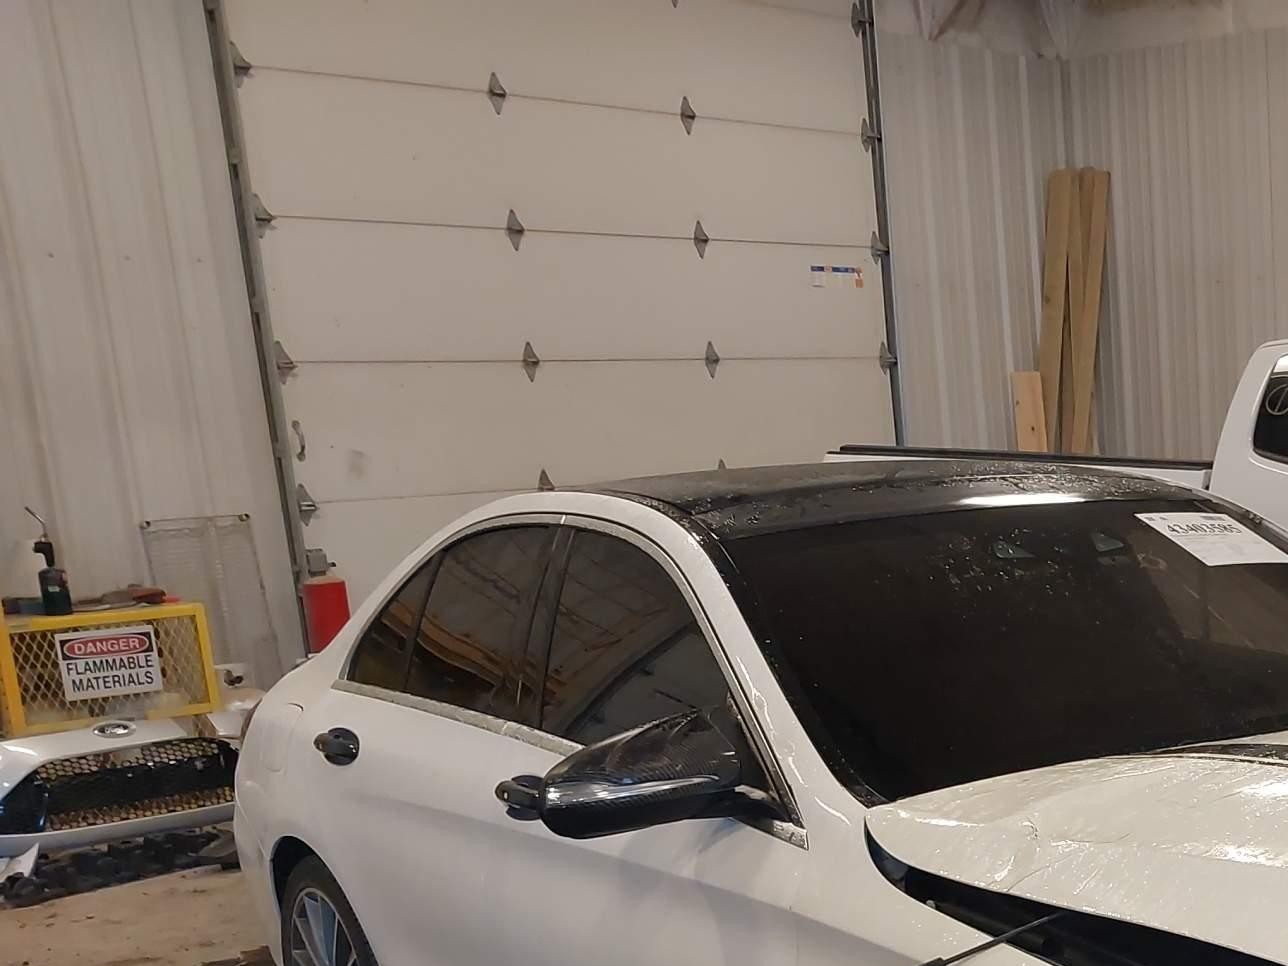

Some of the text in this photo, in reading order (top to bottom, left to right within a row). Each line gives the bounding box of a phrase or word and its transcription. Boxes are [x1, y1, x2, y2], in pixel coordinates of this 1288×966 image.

[1167, 523, 1243, 535] 43403585
[74, 638, 140, 655] DANGER
[66, 654, 155, 677] FLAMMABLE
[71, 671, 154, 692] MATERIALS
